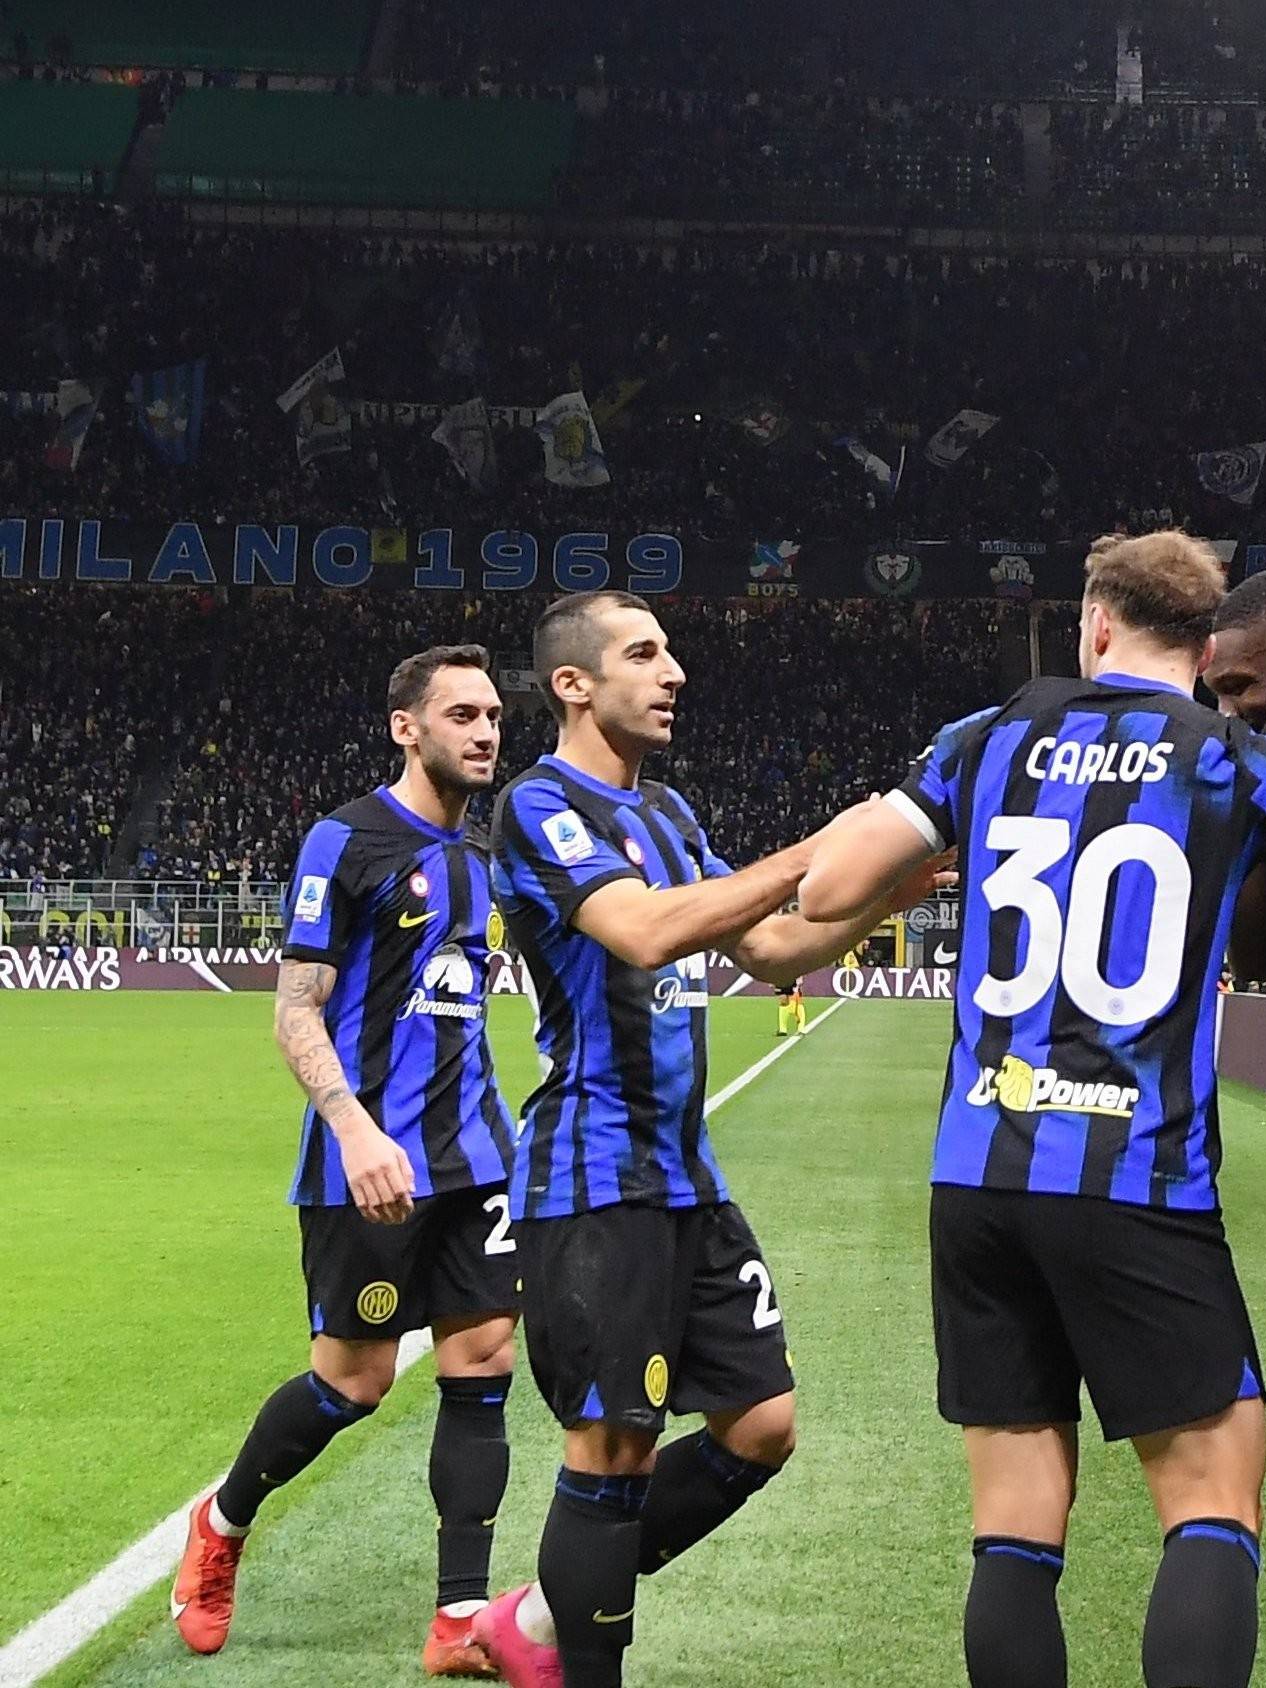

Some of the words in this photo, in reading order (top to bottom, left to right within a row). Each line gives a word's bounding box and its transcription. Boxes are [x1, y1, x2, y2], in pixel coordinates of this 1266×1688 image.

[414, 527, 684, 594] 1969
[746, 582, 799, 598] BOYS
[1026, 736, 1174, 784] CARLOS
[973, 815, 1192, 1026] 30
[832, 966, 953, 999] QATAR
